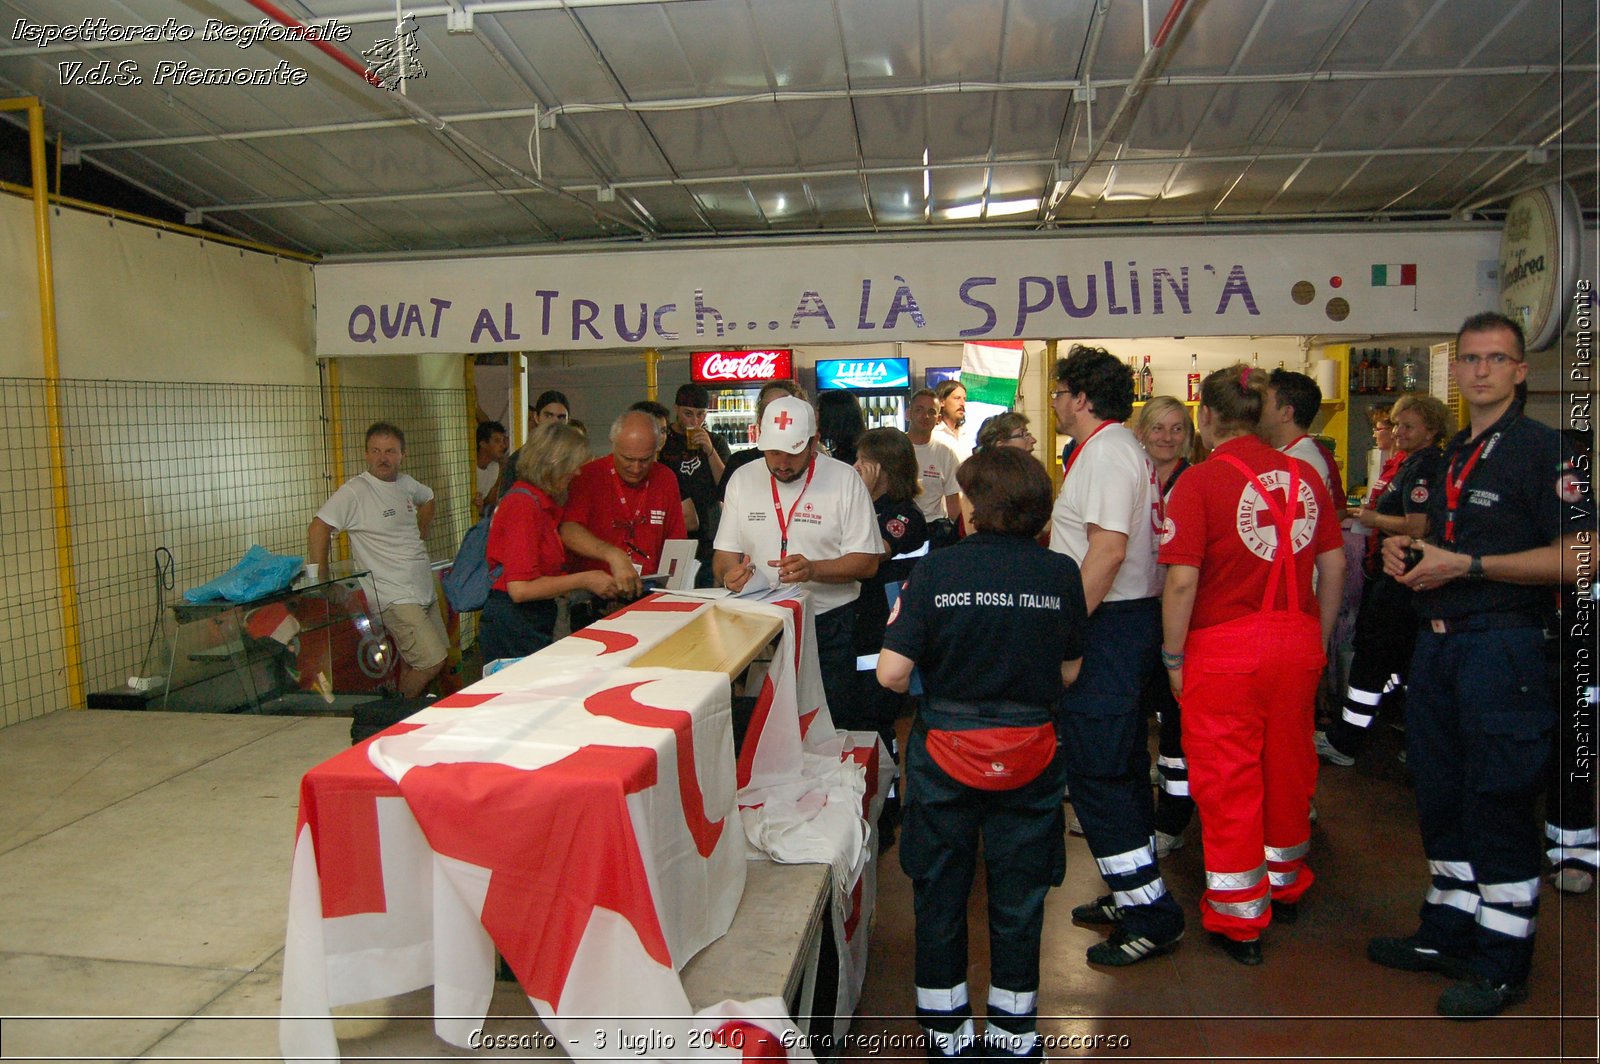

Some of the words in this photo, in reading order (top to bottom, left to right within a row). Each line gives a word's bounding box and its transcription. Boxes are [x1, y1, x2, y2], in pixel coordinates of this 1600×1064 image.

[348, 298, 451, 344] QUAT
[470, 302, 520, 344] AL
[836, 361, 888, 378] LILIA
[934, 592, 972, 608] CROCE
[975, 592, 1014, 607] ROSSA
[1019, 594, 1061, 611] ITALIANA
